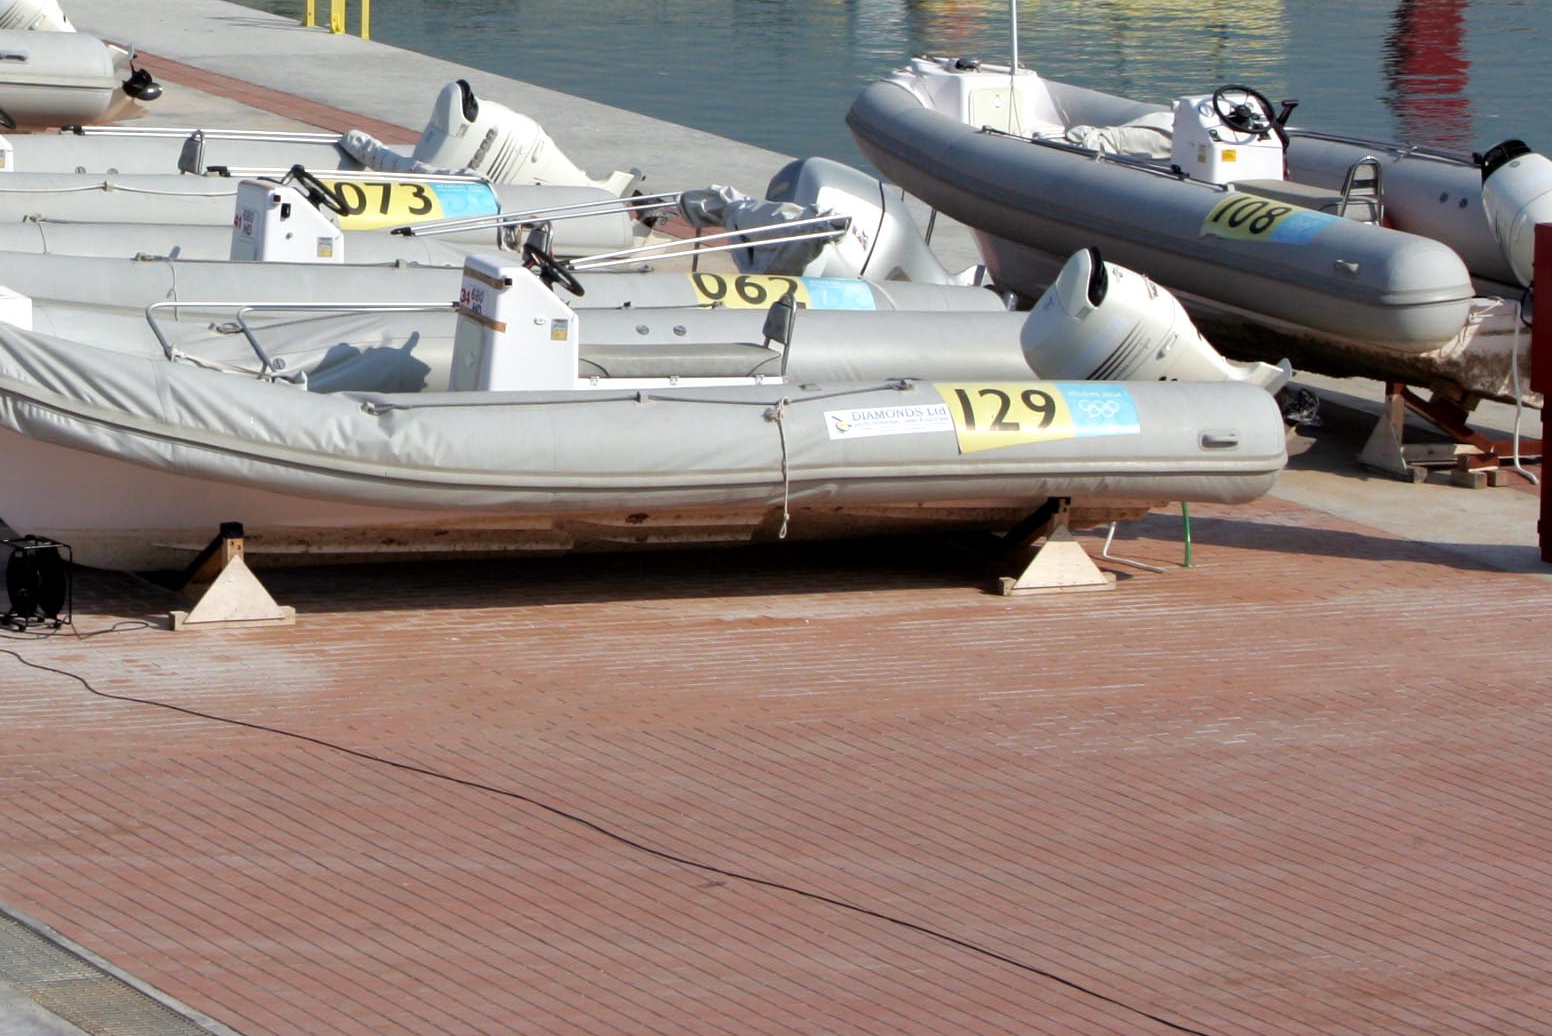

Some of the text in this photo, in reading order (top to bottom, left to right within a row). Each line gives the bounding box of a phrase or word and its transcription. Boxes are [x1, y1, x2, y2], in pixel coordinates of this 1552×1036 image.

[334, 182, 433, 215] 073
[1212, 196, 1293, 235] 108
[692, 273, 806, 309] 062
[851, 406, 947, 421] DIAMONDS Ltd
[955, 388, 1056, 431] 129
